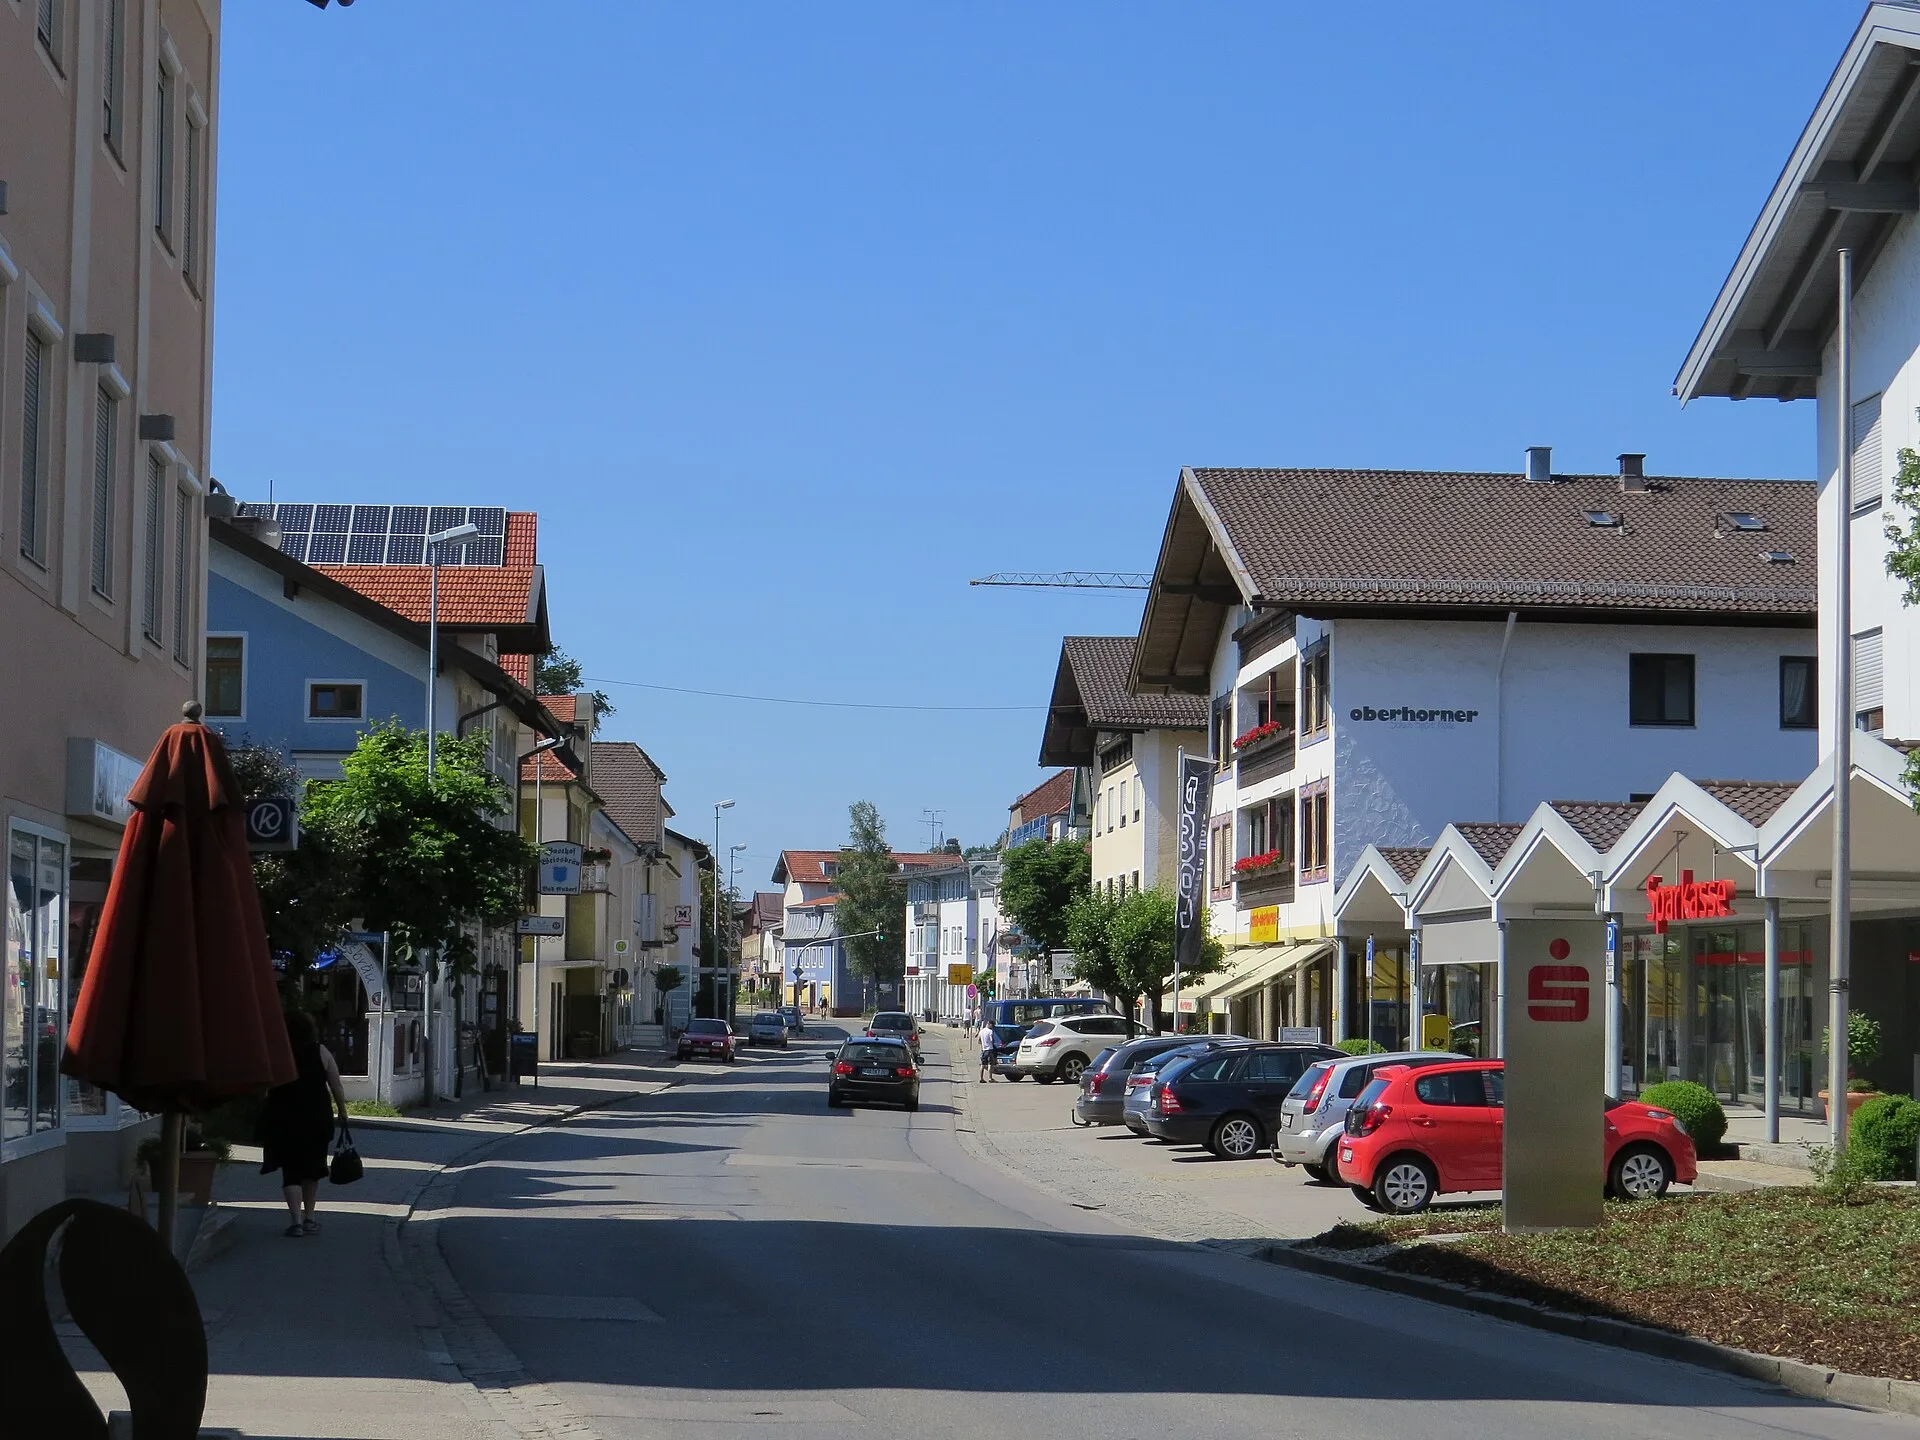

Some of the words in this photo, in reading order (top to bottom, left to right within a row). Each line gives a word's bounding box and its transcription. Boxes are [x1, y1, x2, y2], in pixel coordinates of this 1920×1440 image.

[1350, 706, 1479, 722] oberhorner
[1179, 776, 1199, 929] LOWA
[1646, 870, 1735, 934] Sparkasse
[1607, 926, 1613, 950] P
